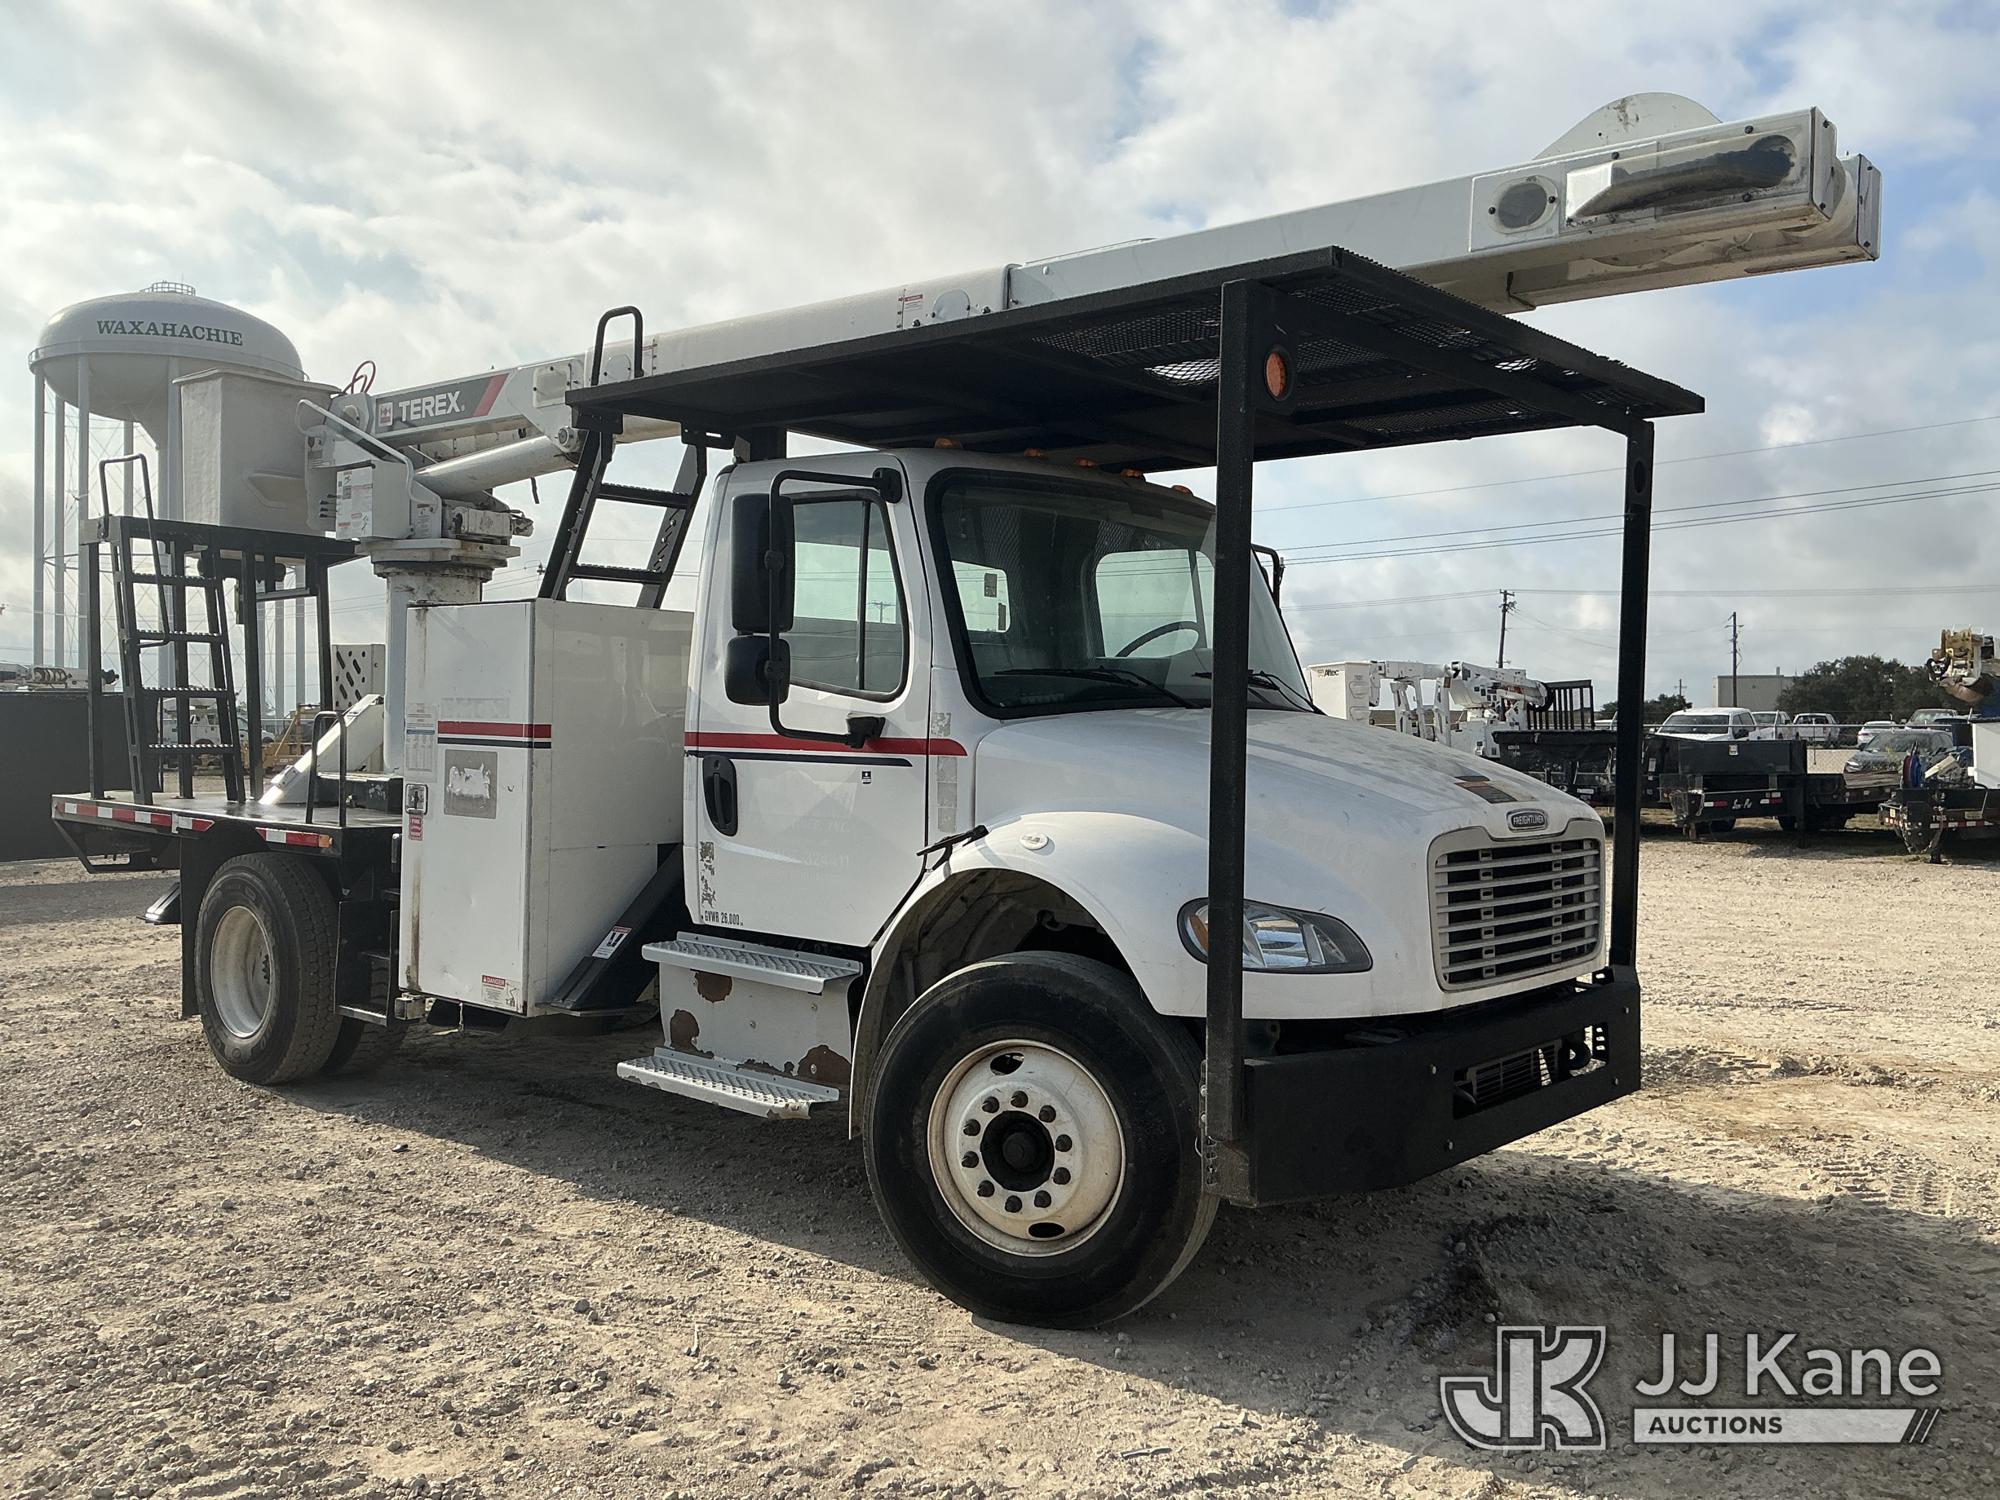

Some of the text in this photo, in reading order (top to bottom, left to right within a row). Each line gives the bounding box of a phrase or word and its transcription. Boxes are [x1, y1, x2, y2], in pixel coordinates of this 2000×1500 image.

[97, 320, 243, 346] WAXAHACHIE
[398, 391, 461, 422] TEREX
[704, 910, 719, 923] GVWR
